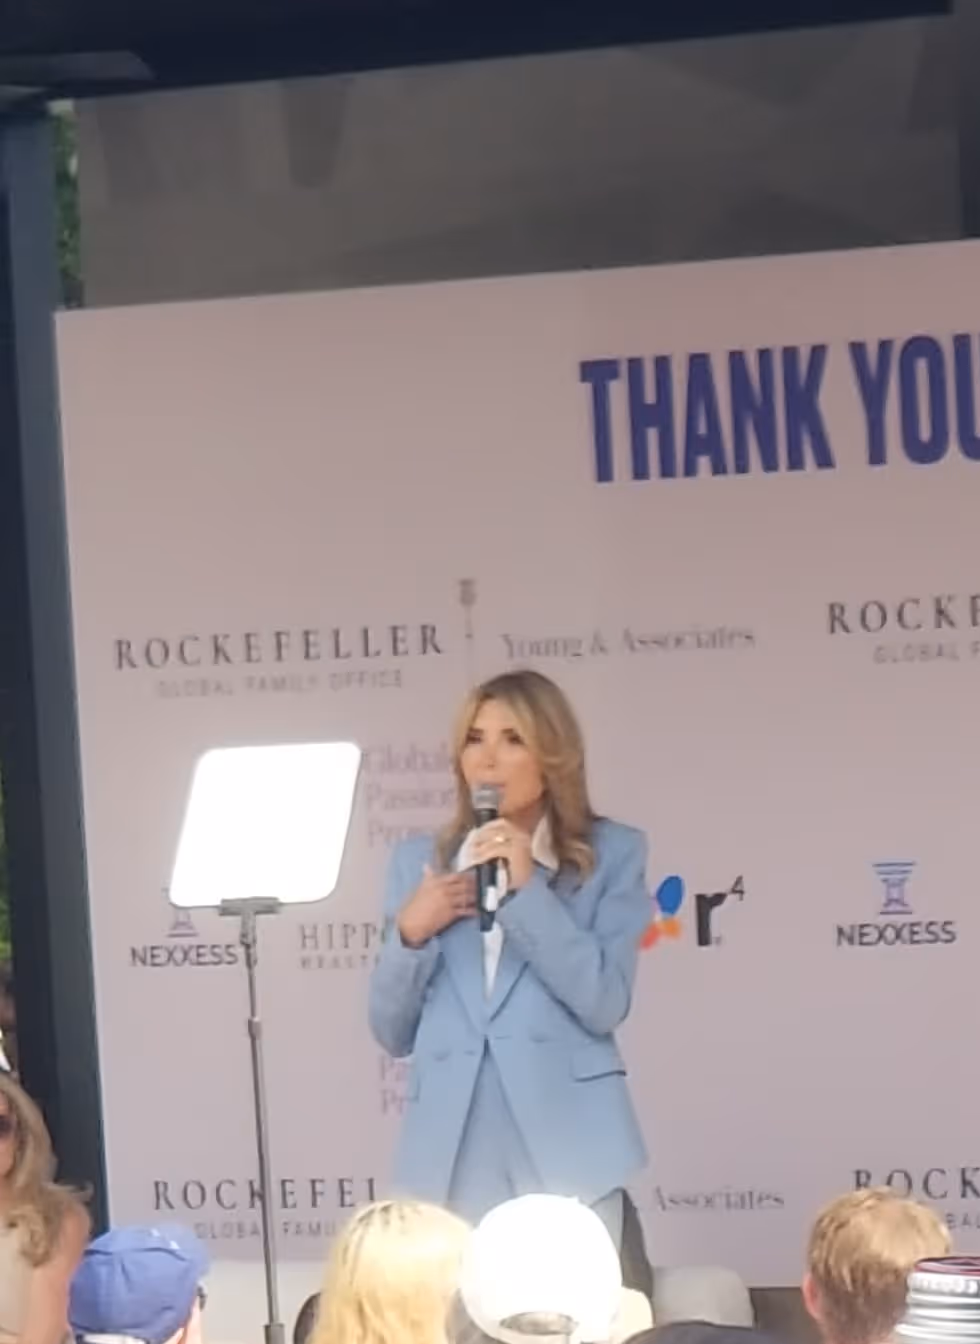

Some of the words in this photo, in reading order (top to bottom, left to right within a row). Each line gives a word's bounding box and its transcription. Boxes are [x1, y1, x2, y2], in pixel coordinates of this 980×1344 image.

[579, 343, 836, 484] THANK
[114, 624, 443, 671] ROCKEFELLER
[501, 633, 584, 662] Young
[590, 628, 610, 657] &
[622, 625, 756, 654] Associates
[873, 642, 960, 664] GLOBAL
[156, 678, 235, 700] GLOBAL
[329, 669, 403, 692] OFFICE
[836, 920, 957, 947] NEXXESS
[130, 944, 239, 968] NEXXESS
[194, 1219, 261, 1240] GLOBA
